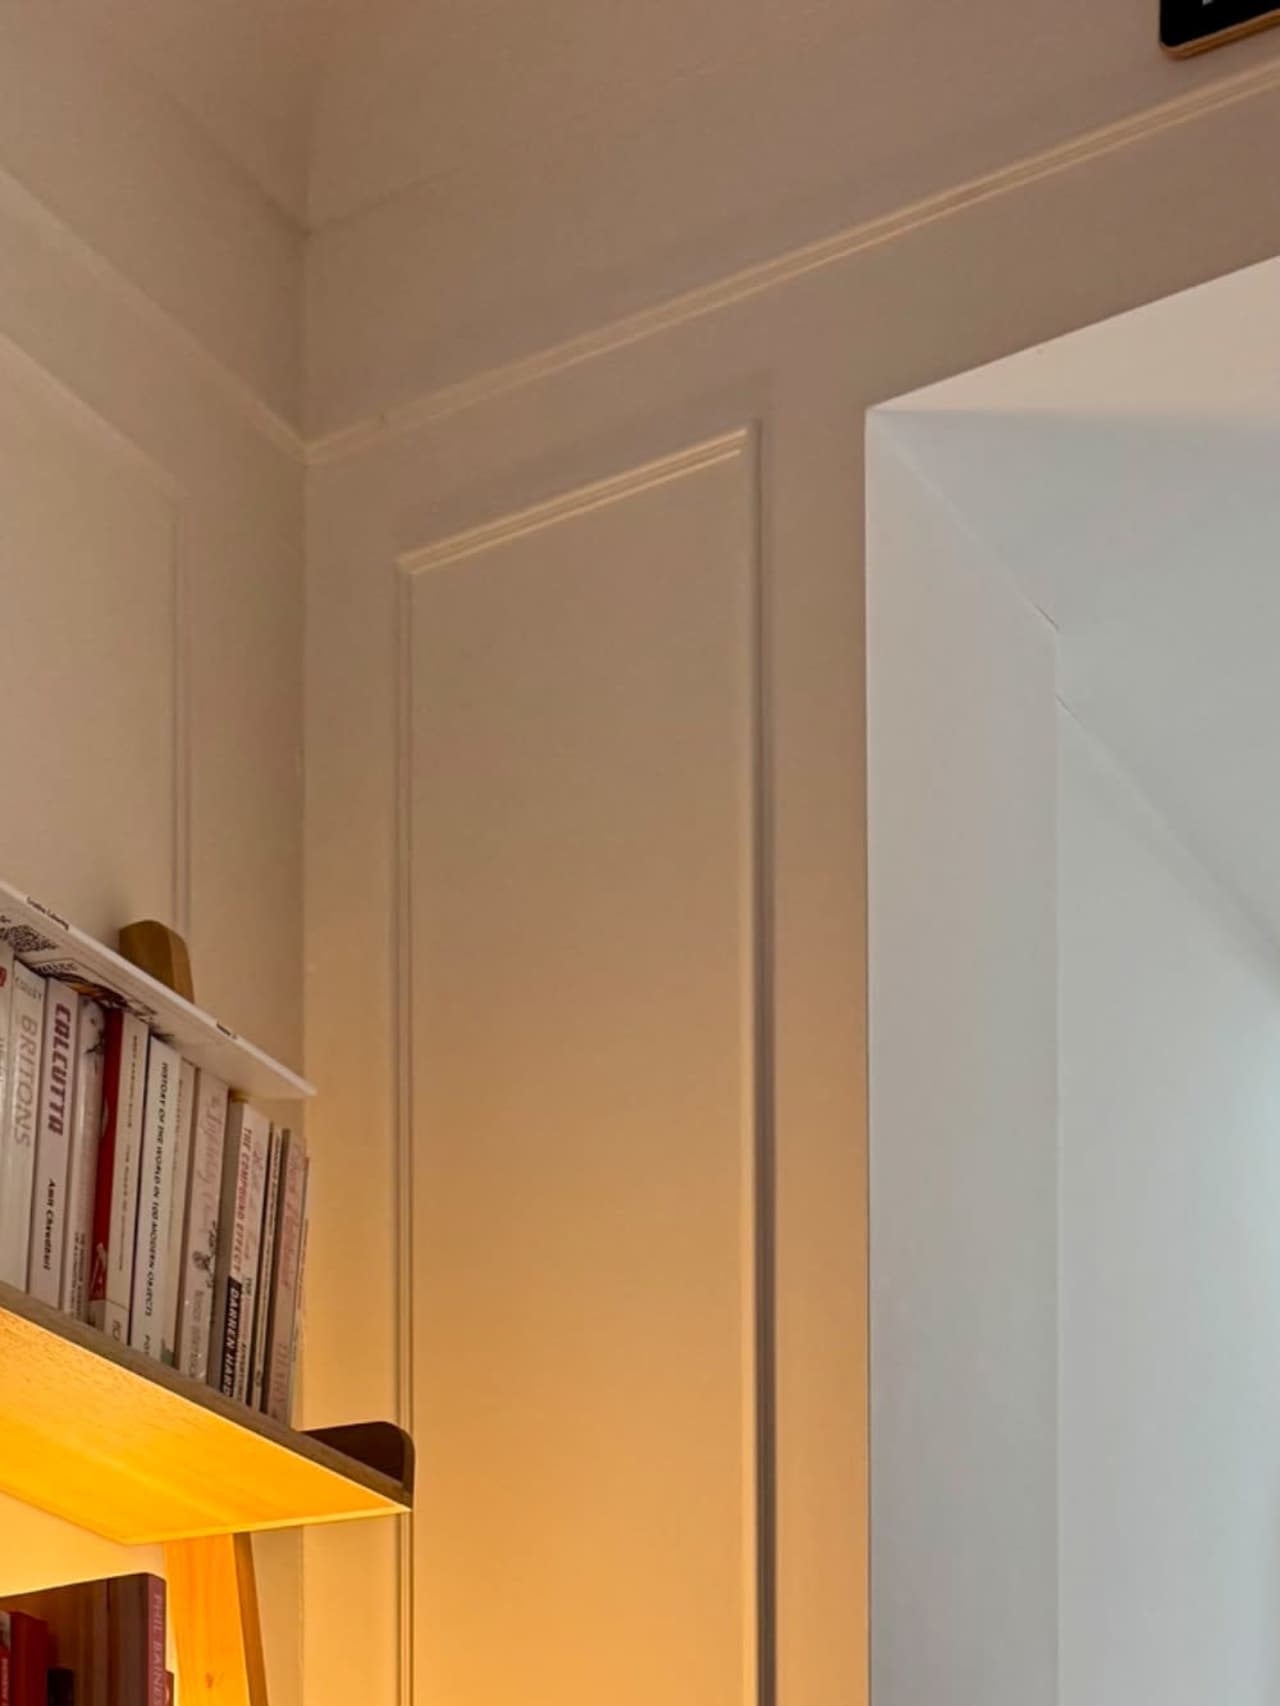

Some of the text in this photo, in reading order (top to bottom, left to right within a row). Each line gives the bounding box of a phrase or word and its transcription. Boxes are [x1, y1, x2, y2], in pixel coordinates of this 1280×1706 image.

[14, 1014, 39, 1148] BRITONS
[47, 1001, 72, 1137] CALCUTTA
[158, 1061, 169, 1105] HISTORY
[153, 1142, 165, 1185] WORLD
[220, 1285, 240, 1397] DARREN HARD
